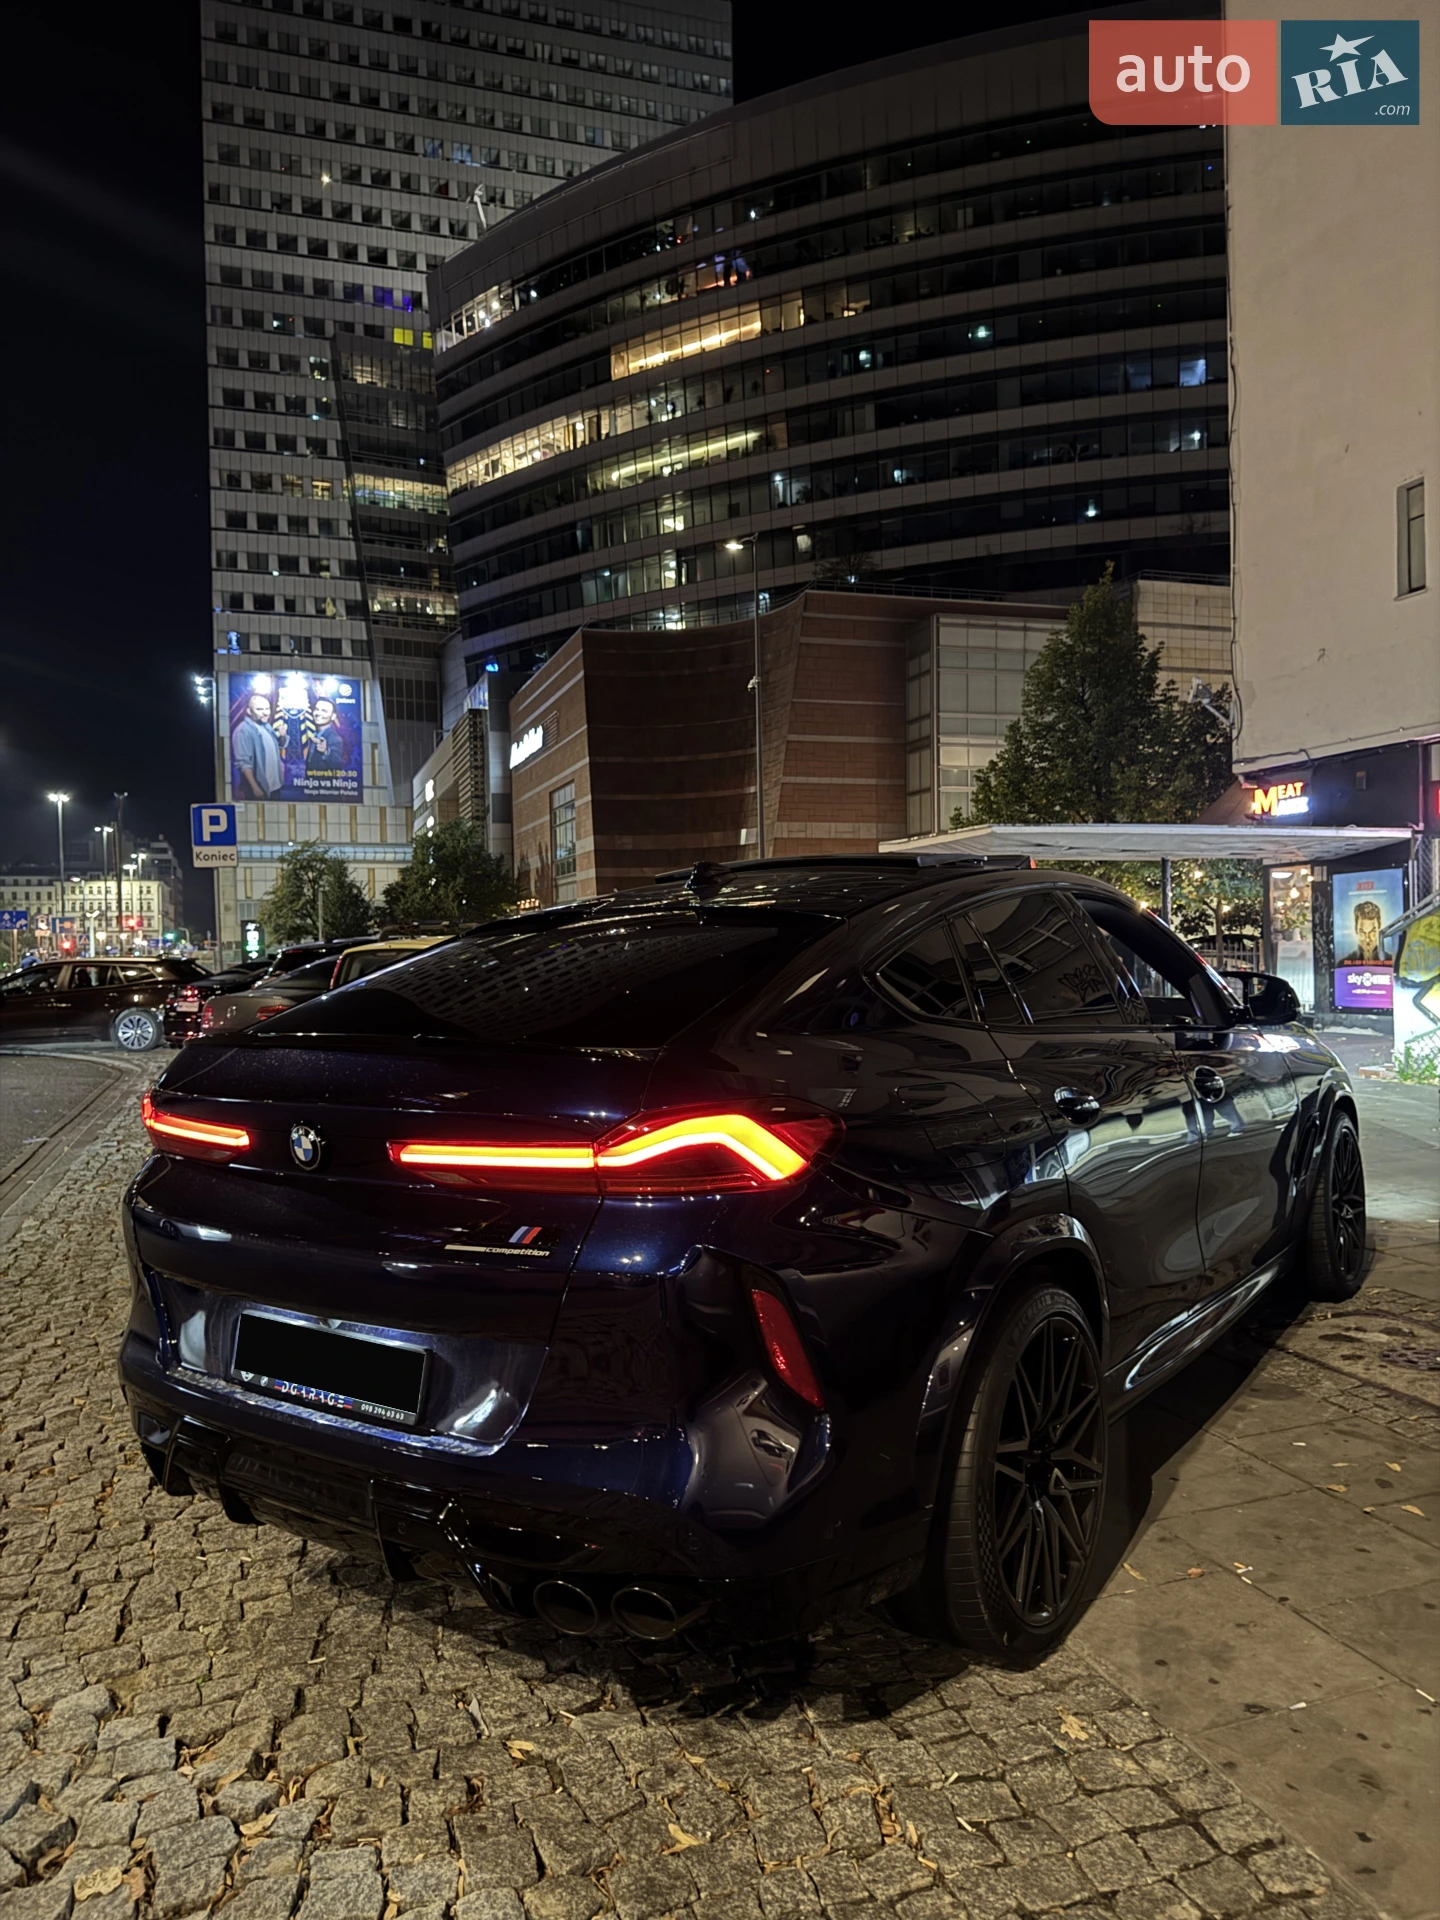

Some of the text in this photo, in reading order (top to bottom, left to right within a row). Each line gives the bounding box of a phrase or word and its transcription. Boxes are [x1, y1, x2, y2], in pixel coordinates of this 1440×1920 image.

[293, 778, 319, 788] Ninja
[332, 778, 358, 789] Ninja
[1254, 781, 1304, 816] MEAT
[201, 808, 227, 842] P
[195, 851, 235, 861] Koniec
[485, 1246, 550, 1257] competition
[361, 1403, 373, 1414] 098
[373, 1405, 386, 1416] 294
[386, 1409, 395, 1418] 63
[395, 1411, 404, 1420] 63
